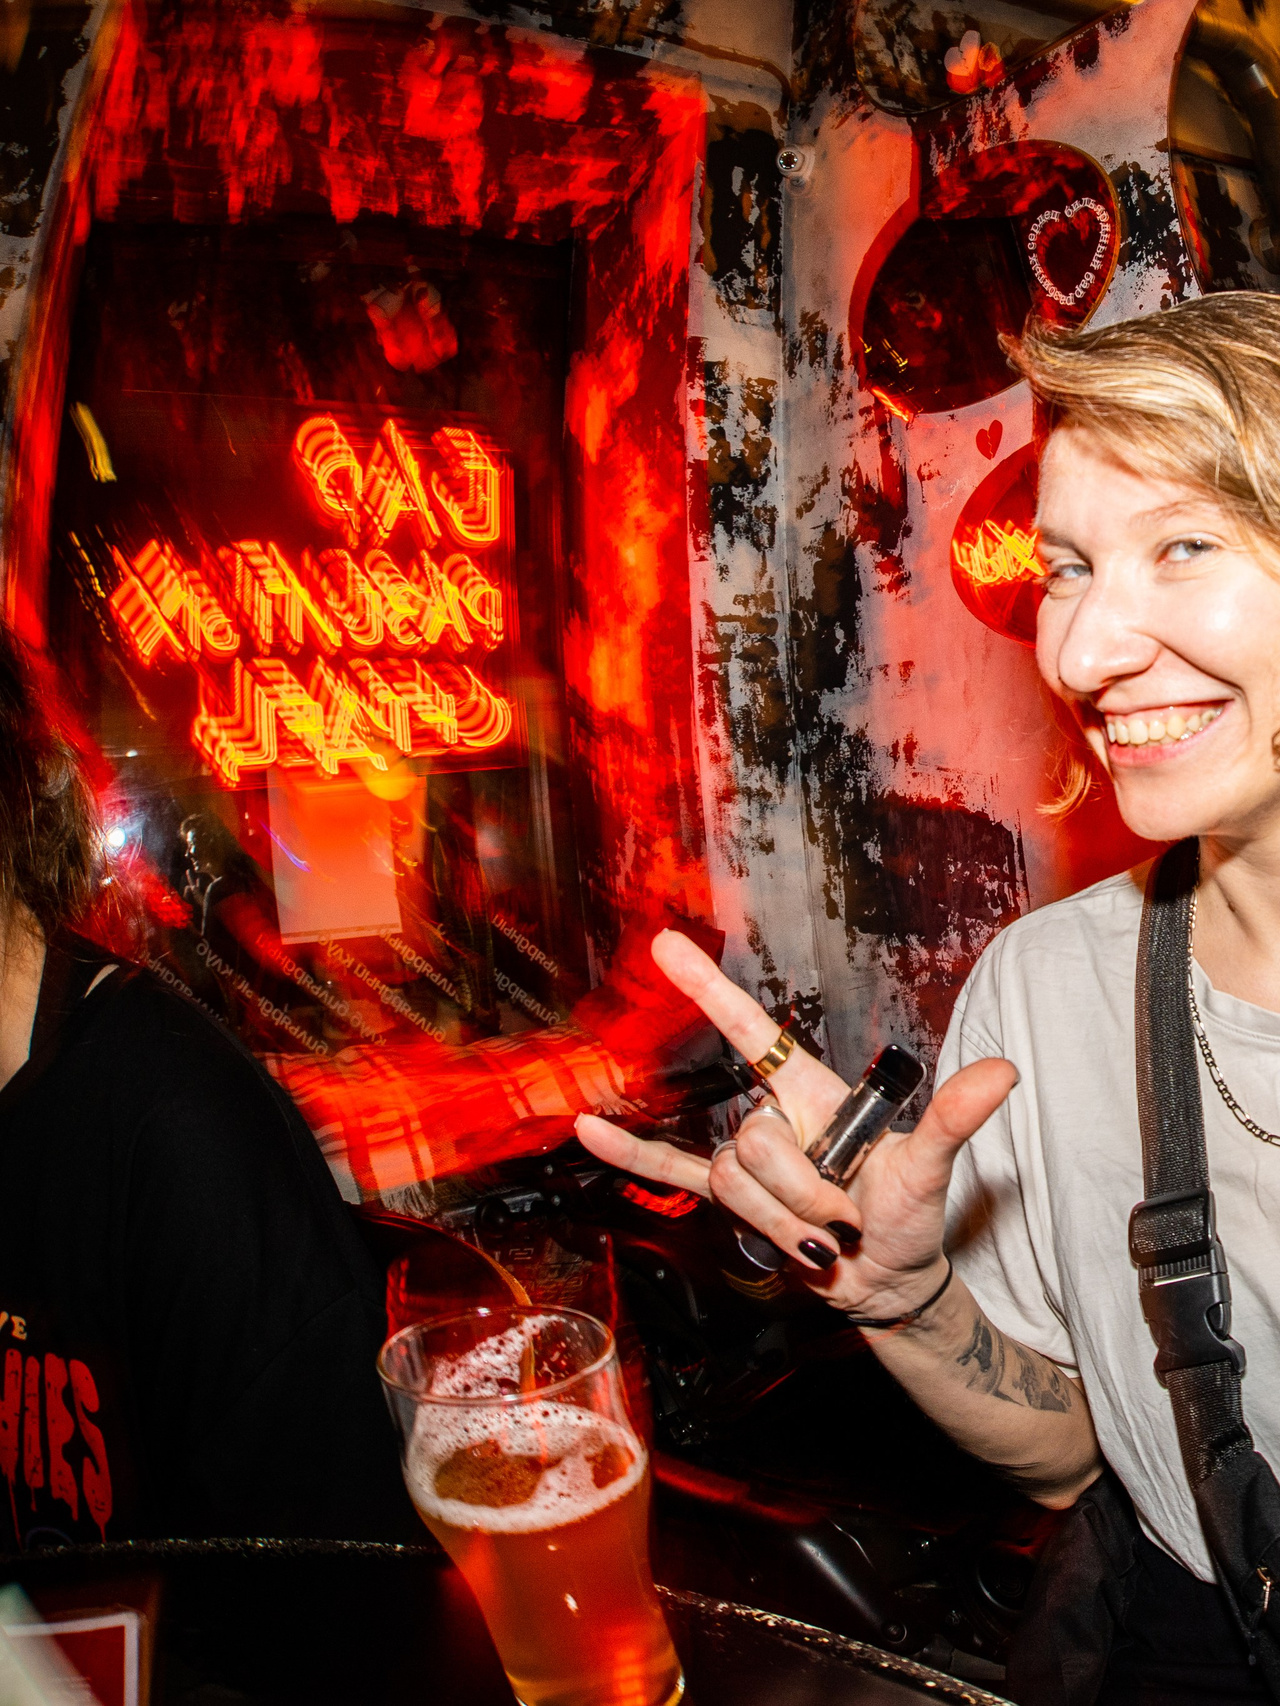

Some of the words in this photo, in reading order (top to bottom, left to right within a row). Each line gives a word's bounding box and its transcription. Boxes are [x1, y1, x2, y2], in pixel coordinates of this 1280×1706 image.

[1027, 210, 1061, 250] сердец
[1064, 197, 1112, 271] бильярдный
[1028, 253, 1076, 306] разбитых
[1075, 271, 1096, 298] бар
